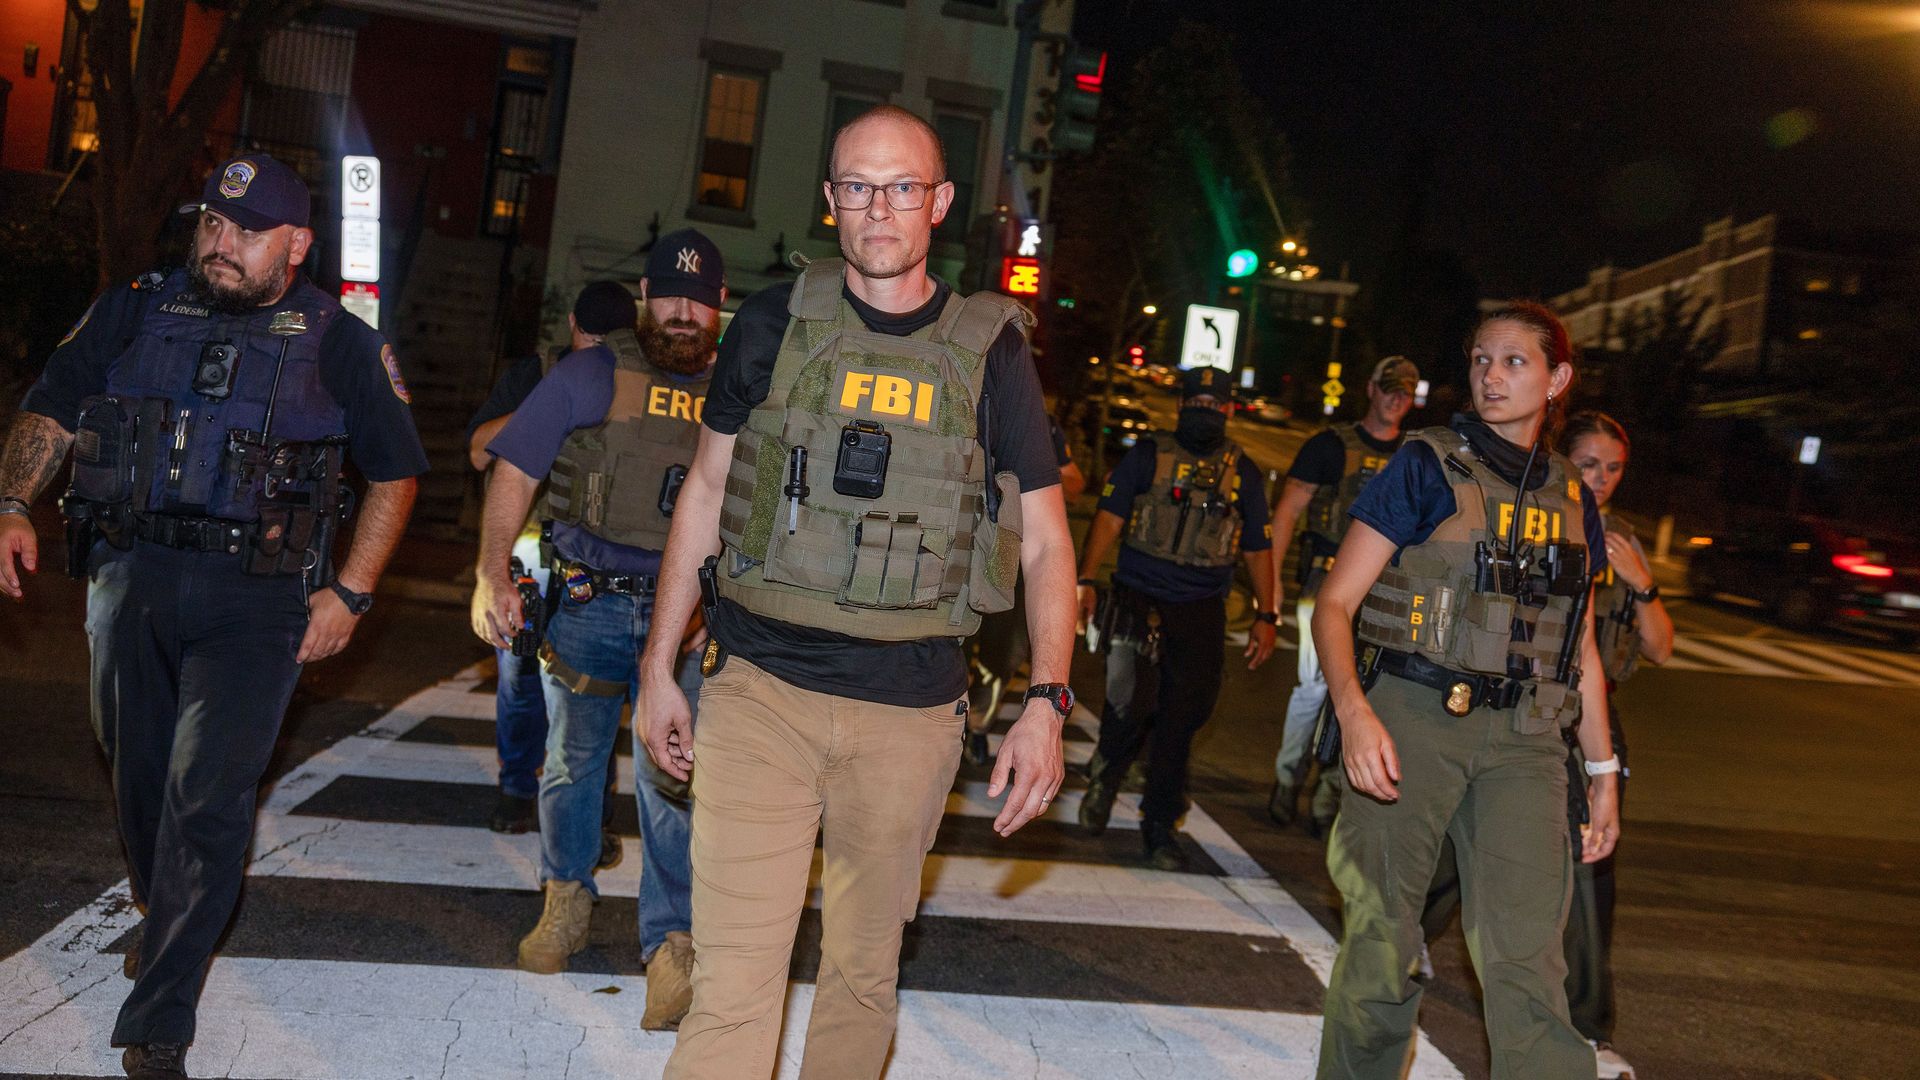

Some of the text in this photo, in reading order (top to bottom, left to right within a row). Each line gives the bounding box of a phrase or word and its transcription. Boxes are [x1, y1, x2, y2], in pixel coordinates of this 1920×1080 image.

[676, 247, 701, 273] NY
[1193, 351, 1221, 364] ONY
[840, 371, 934, 422] FBI
[1499, 503, 1561, 543] FBI
[1410, 595, 1425, 641] FBI
